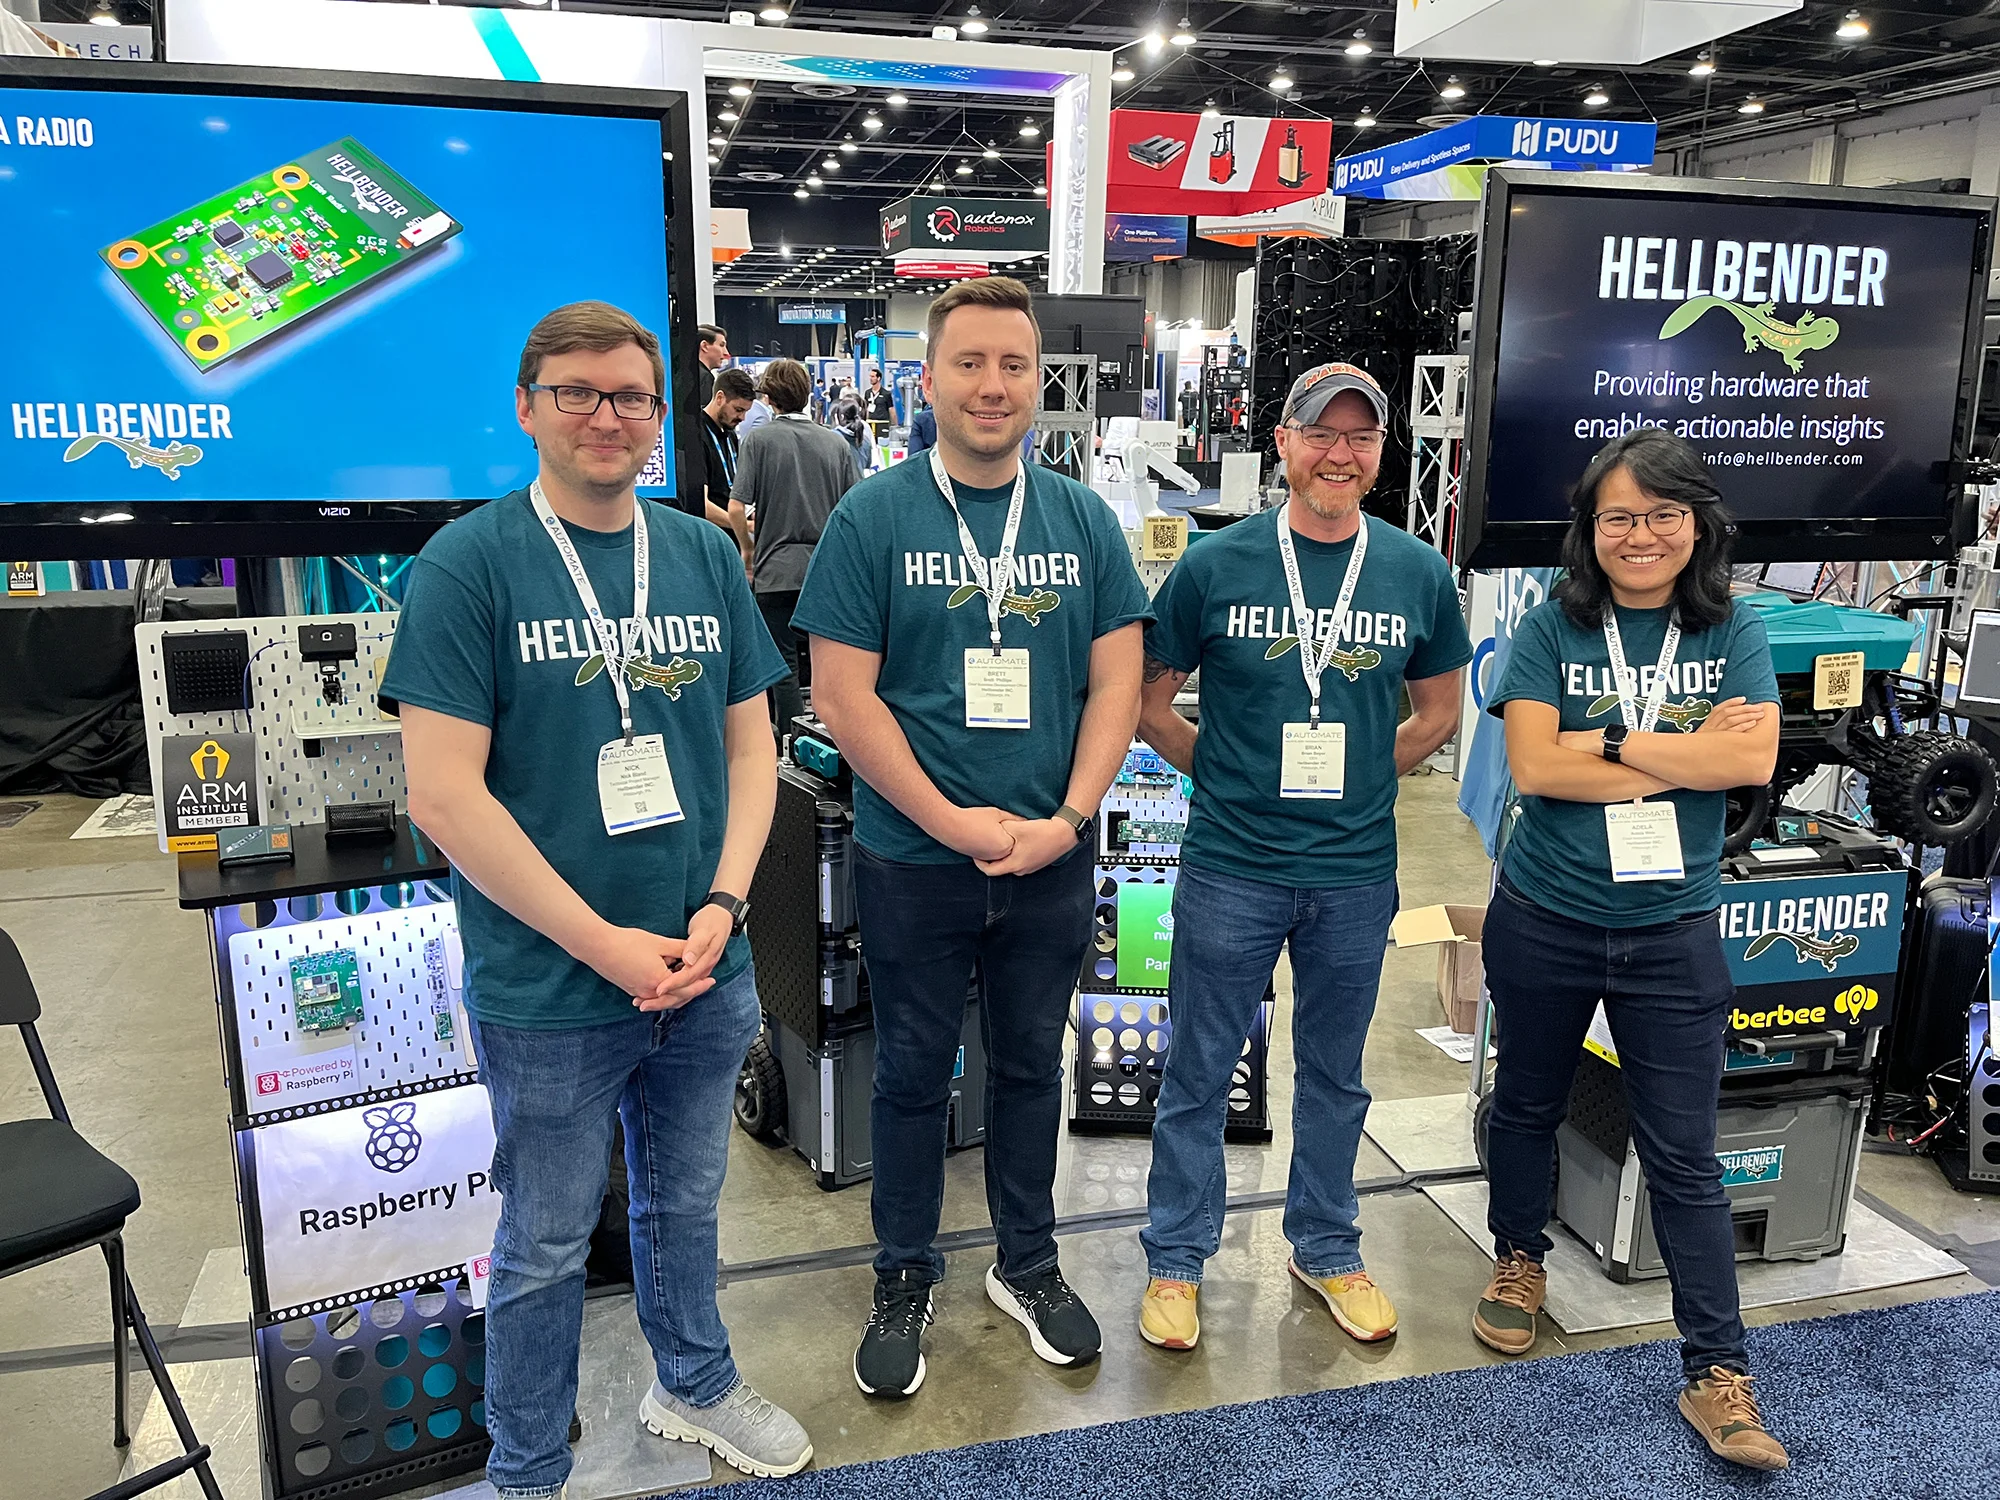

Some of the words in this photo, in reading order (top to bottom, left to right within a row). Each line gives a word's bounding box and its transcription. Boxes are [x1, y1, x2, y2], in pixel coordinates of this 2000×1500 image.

[16, 116, 94, 148] RADIO
[1545, 127, 1618, 155] PUDU
[1350, 156, 1384, 184] PUDU
[1390, 165, 1401, 175] Easy
[1402, 159, 1420, 172] Delivery
[1421, 155, 1431, 166] and
[1431, 149, 1452, 164] Spotless
[1452, 143, 1470, 156] Spaces
[326, 153, 409, 220] HELLBENDER
[964, 211, 1036, 225] autonox
[1319, 198, 1338, 219] PMI
[964, 225, 1006, 233] Robotics
[1598, 236, 1889, 307] HELLBENDER
[814, 309, 833, 320] STAGE
[1594, 370, 1703, 404] Providing
[1710, 372, 1819, 399] hardware
[1824, 373, 1870, 399] that
[12, 402, 234, 440] HELLBENDER
[1674, 412, 1794, 439] actionable
[1800, 414, 1884, 445] insights
[1702, 451, 1864, 467] info@hellbender.com
[318, 507, 350, 516] VIZIO
[1008, 480, 1023, 529] AUTOMATE
[550, 525, 586, 586] AUTOMATE
[1345, 542, 1365, 594] AUTOMATE
[10, 572, 34, 580] ARM
[993, 553, 1009, 603] AUTOMATE
[1283, 547, 1300, 600] AUTOMATE
[1300, 627, 1314, 679] AUTOMATE
[1319, 620, 1341, 672] AUTOMATE
[1608, 630, 1626, 682] AUTOMATE
[1660, 626, 1680, 674] AUTOMAT
[1561, 658, 1726, 697] ELLBENDER
[1643, 700, 1659, 732] OMATE
[608, 745, 662, 759] AUTOMATE
[176, 780, 247, 804] ARM
[617, 784, 644, 792] Hellbender
[177, 802, 248, 815] INSTITUTE
[186, 816, 241, 826] MEMBER
[1618, 810, 1673, 819] AUTOMATE
[1154, 931, 1173, 941] nvi
[1724, 1004, 1826, 1031] berbee
[286, 1074, 340, 1090] Raspberry
[343, 1070, 354, 1079] Pi
[292, 1060, 338, 1077] Powered
[340, 1059, 352, 1068] by
[1720, 1152, 1778, 1169] HELLBENDER
[300, 1182, 458, 1236] Raspberry
[468, 1169, 495, 1197] Pi
